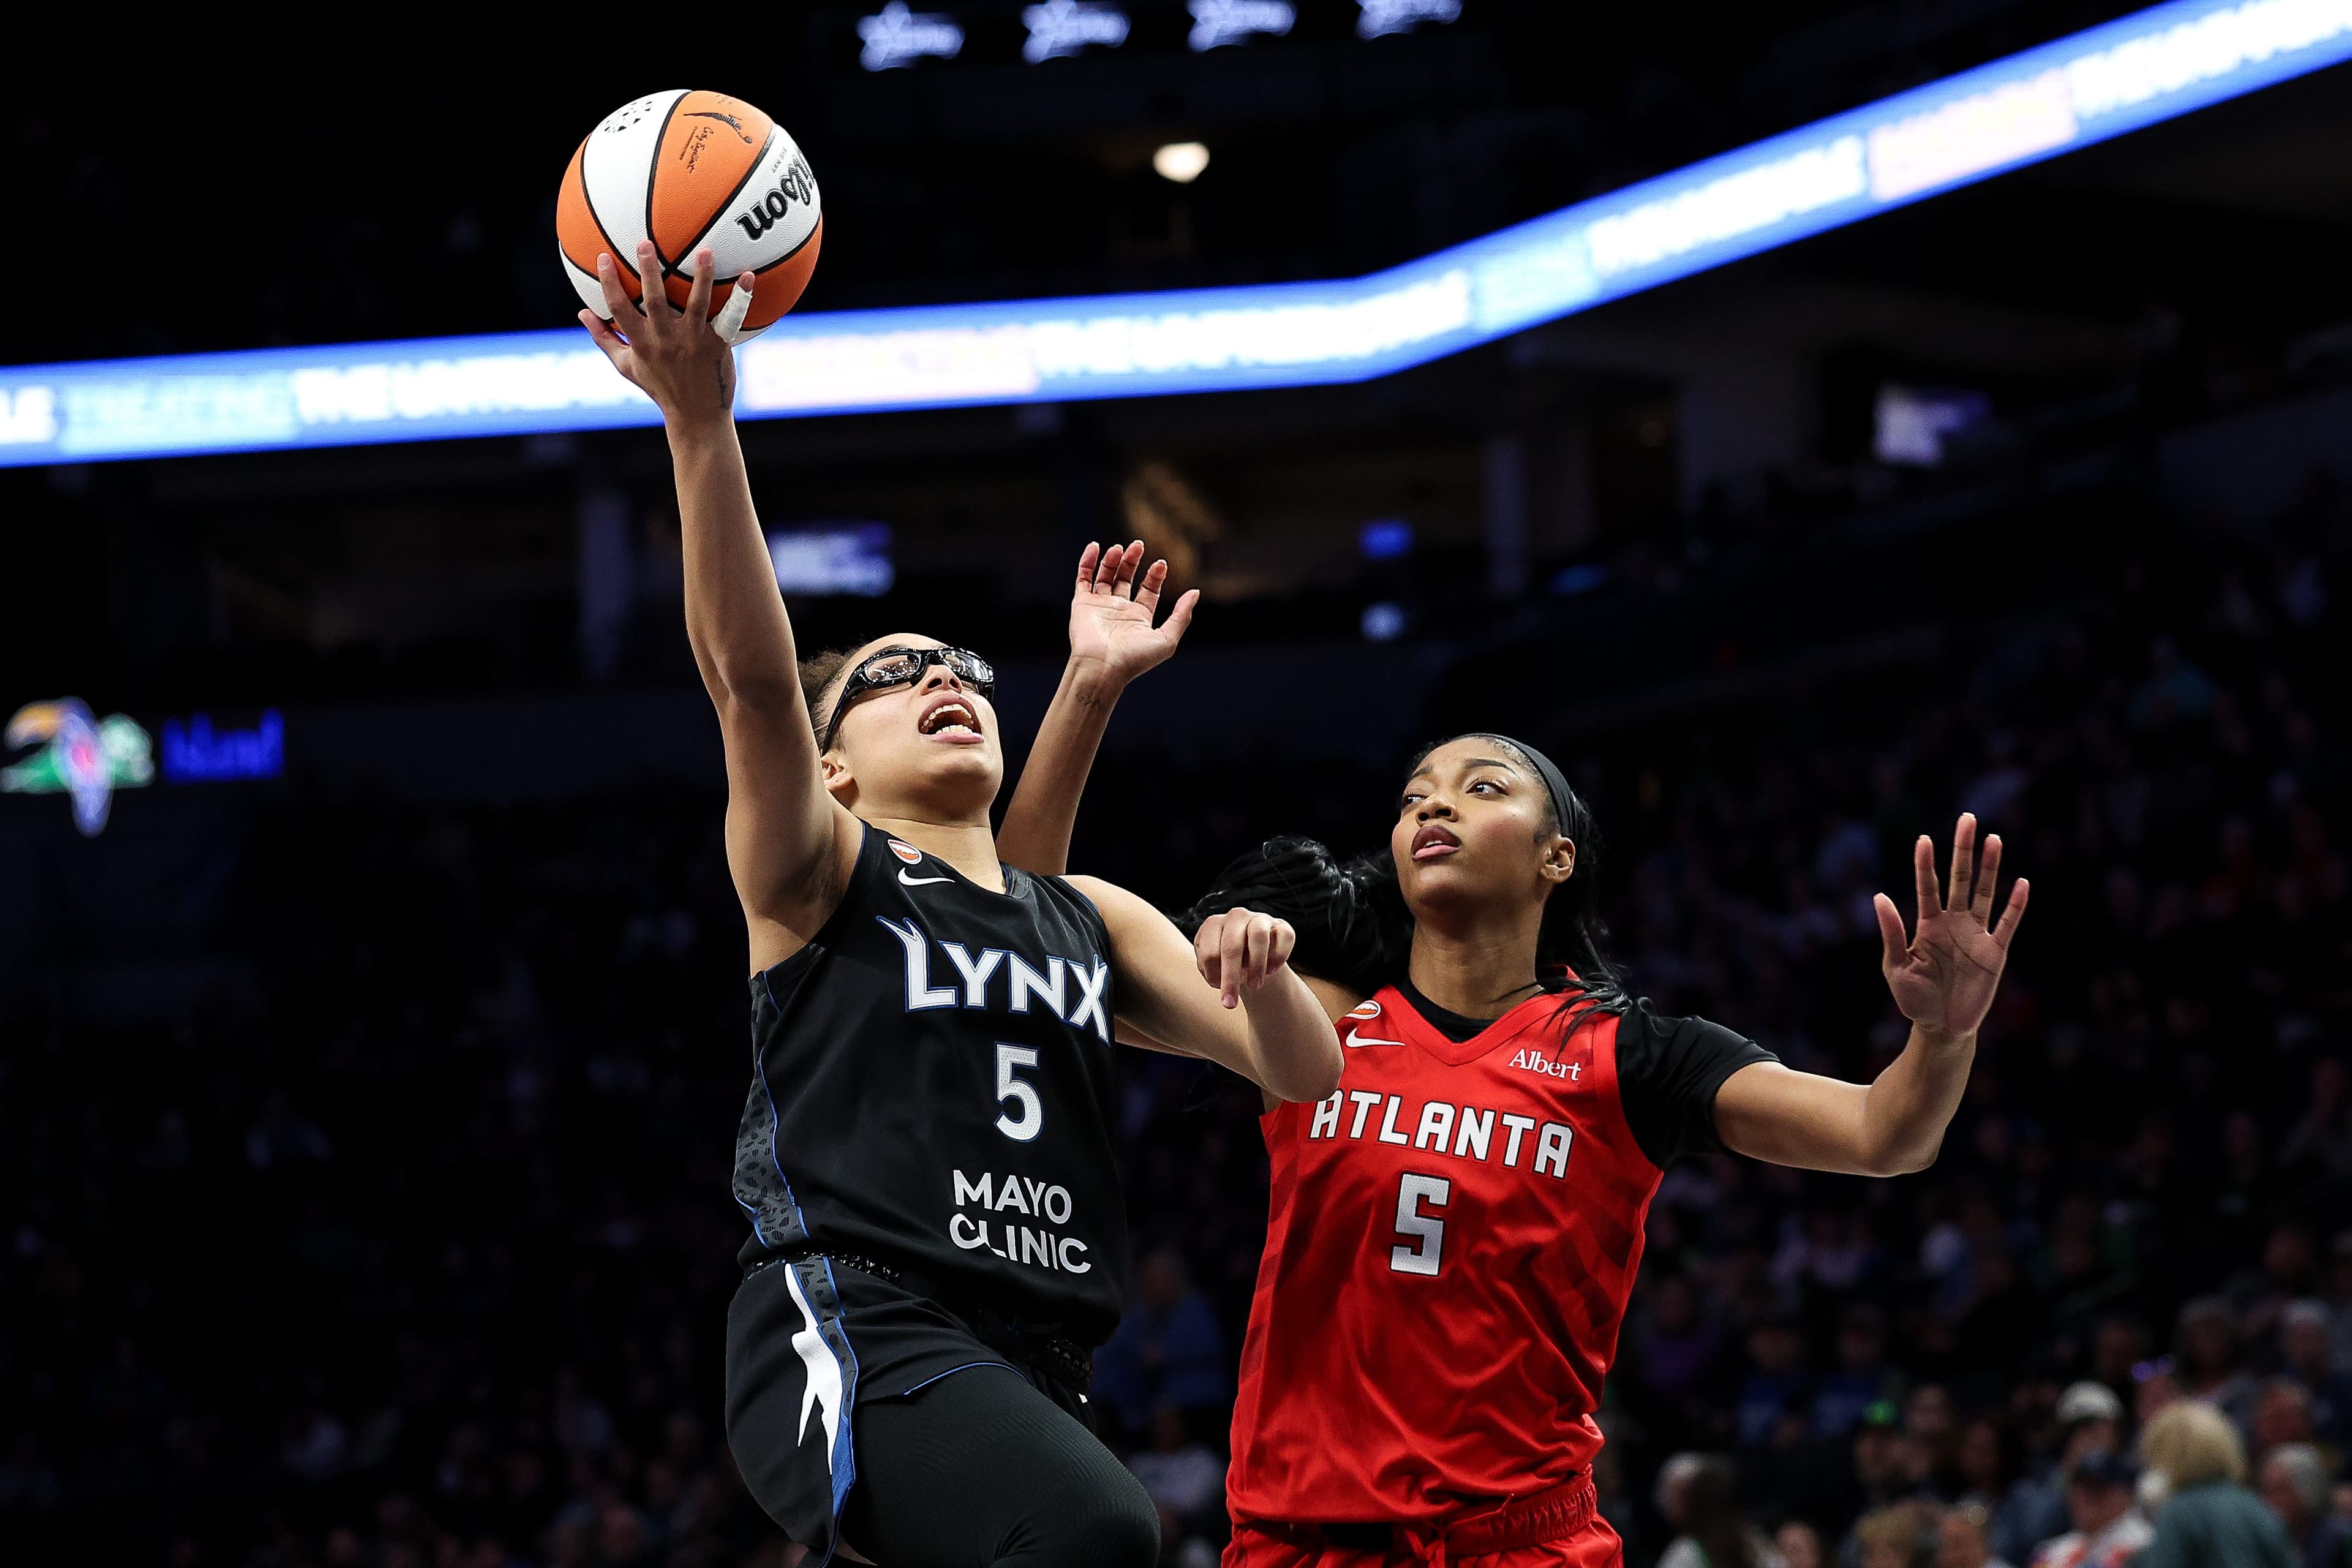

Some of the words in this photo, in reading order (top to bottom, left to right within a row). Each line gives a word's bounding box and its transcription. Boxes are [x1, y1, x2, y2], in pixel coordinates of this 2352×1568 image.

[876, 916, 1110, 1047] LYNX
[993, 1041, 1044, 1143] 5
[1508, 1048, 1582, 1081] Albert
[1309, 1089, 1574, 1180] ATLANTA
[953, 1169, 1072, 1224] MAYO
[1389, 1172, 1451, 1276] 5
[949, 1213, 1091, 1273] CLINIC
